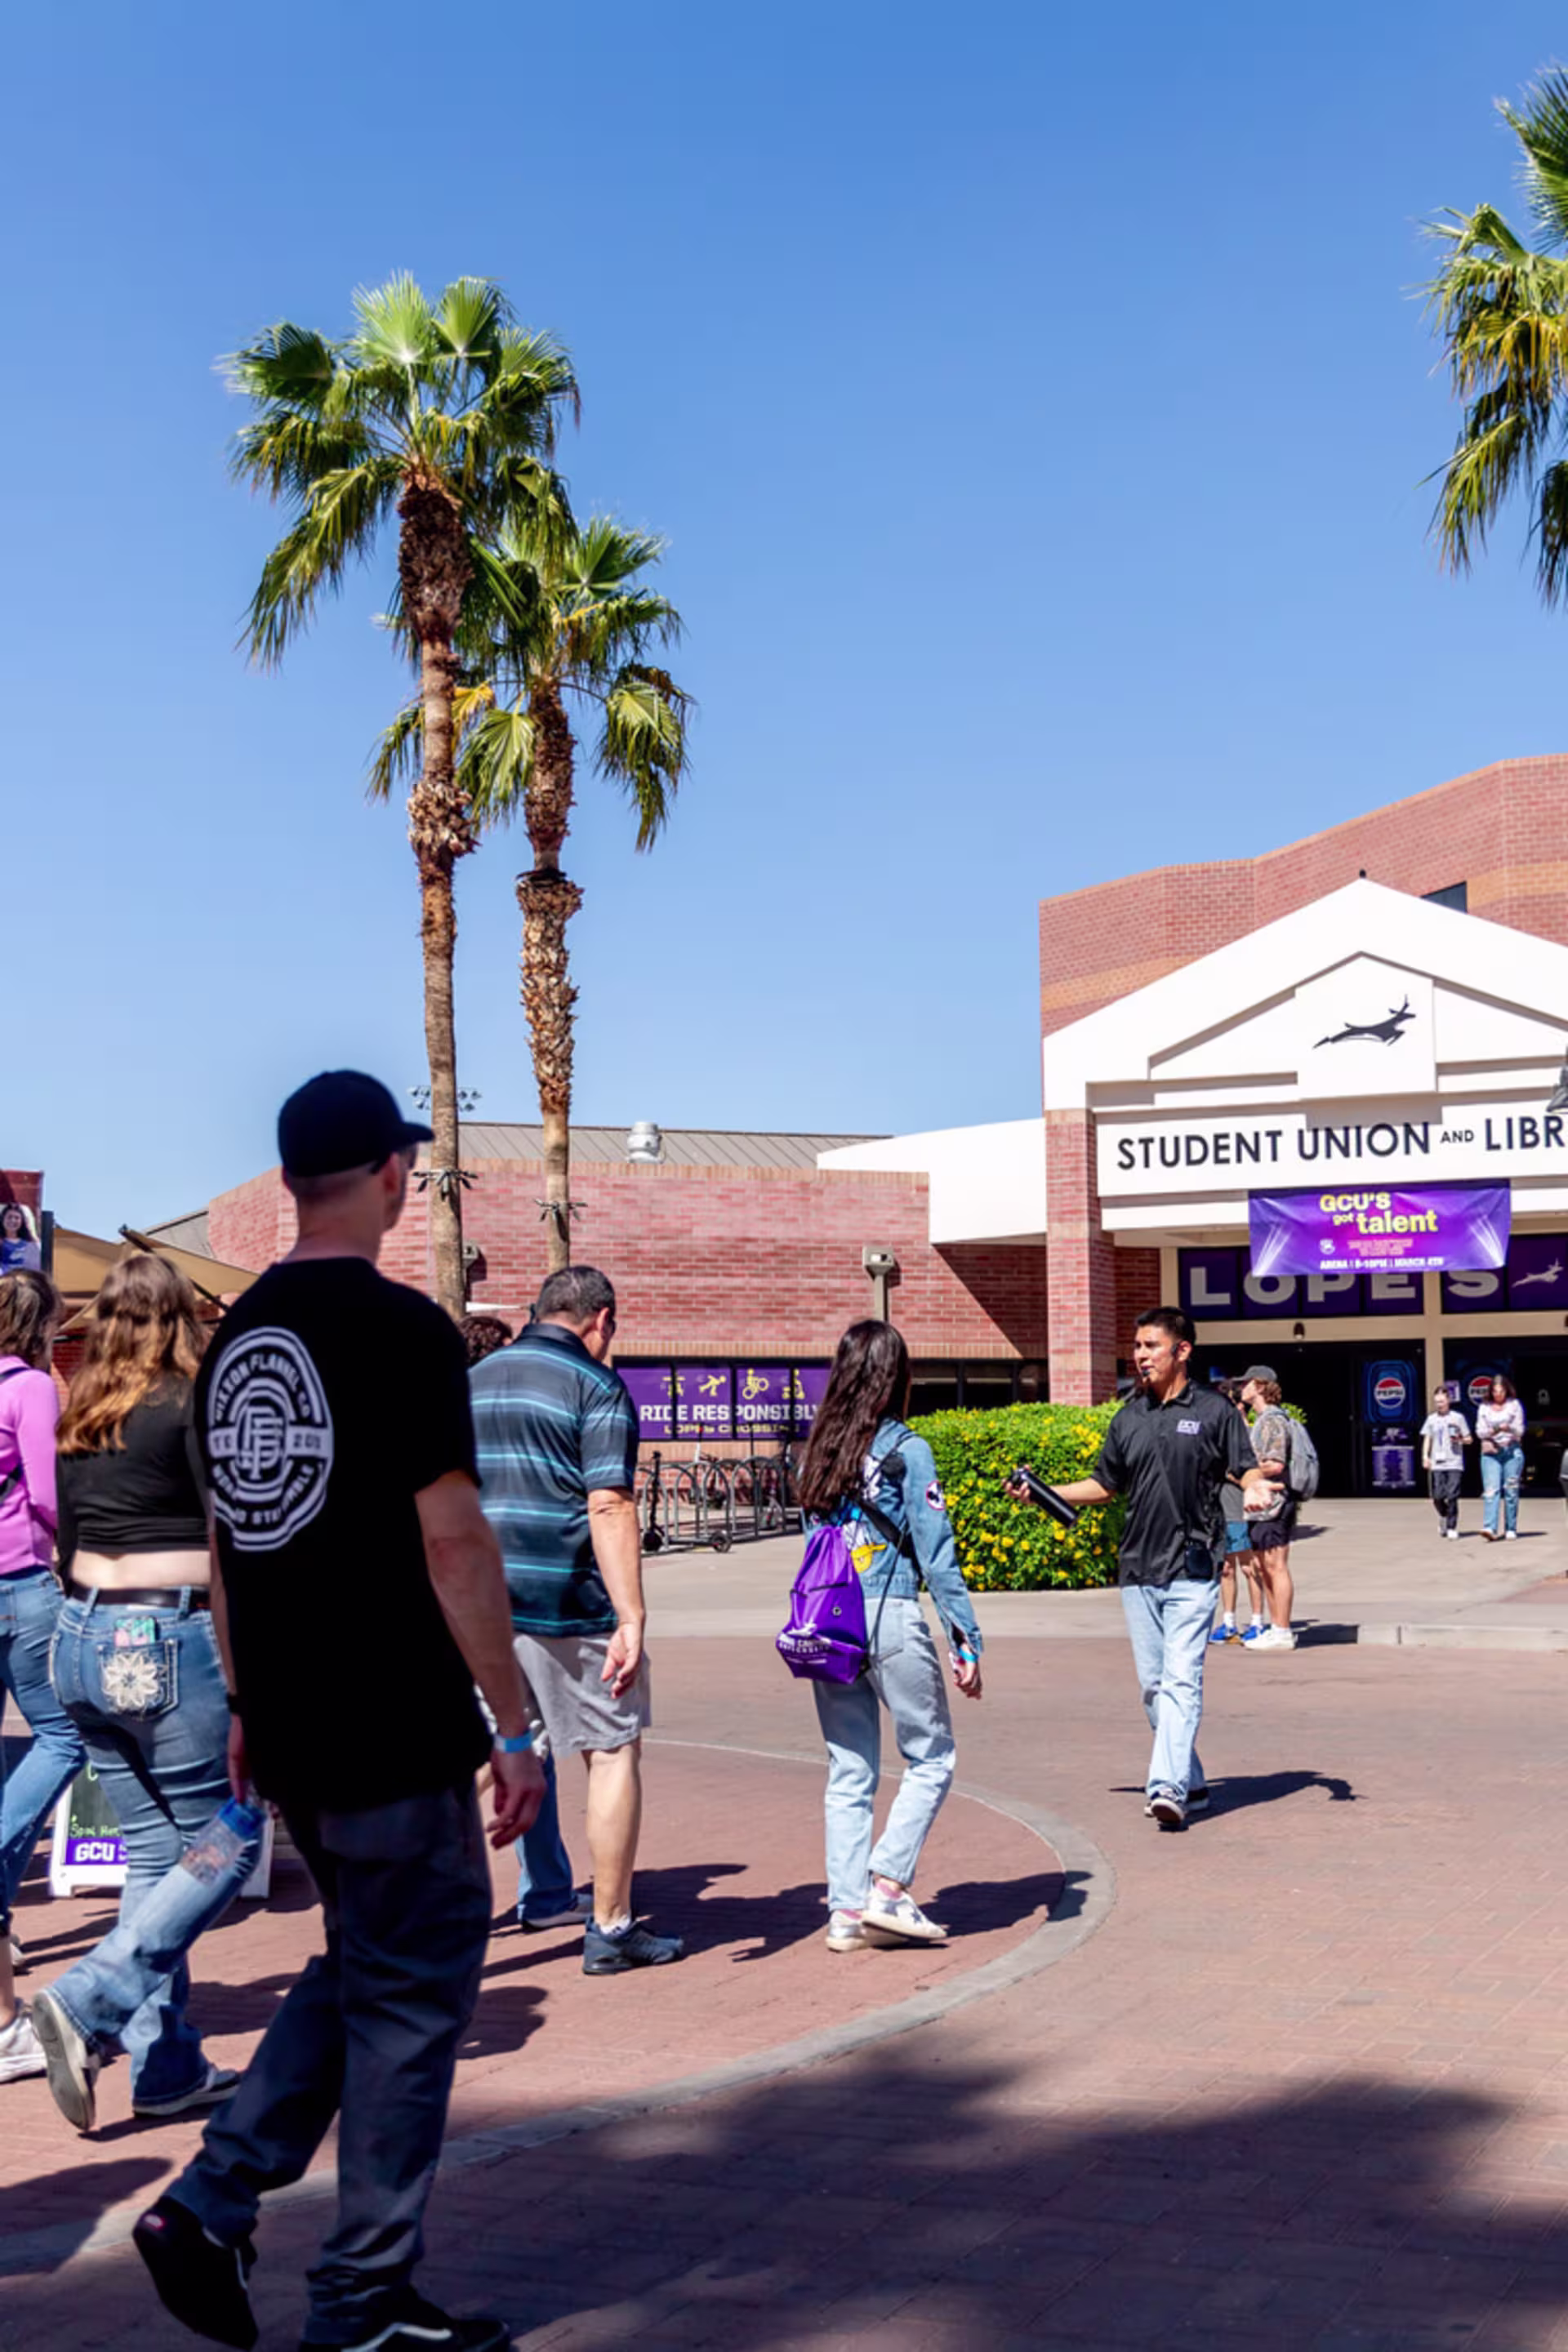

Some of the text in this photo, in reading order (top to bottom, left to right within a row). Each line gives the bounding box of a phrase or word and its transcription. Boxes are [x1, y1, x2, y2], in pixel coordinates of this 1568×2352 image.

[1117, 1129, 1282, 1170] STUDENT
[1297, 1122, 1430, 1161] UNION
[1440, 1129, 1474, 1143] AND
[1320, 1192, 1391, 1212] GCU'S
[1333, 1209, 1438, 1234] got talent
[1190, 1266, 1499, 1306] LOPES
[640, 1405, 688, 1422] RIDE
[75, 1842, 115, 1862] GCU
